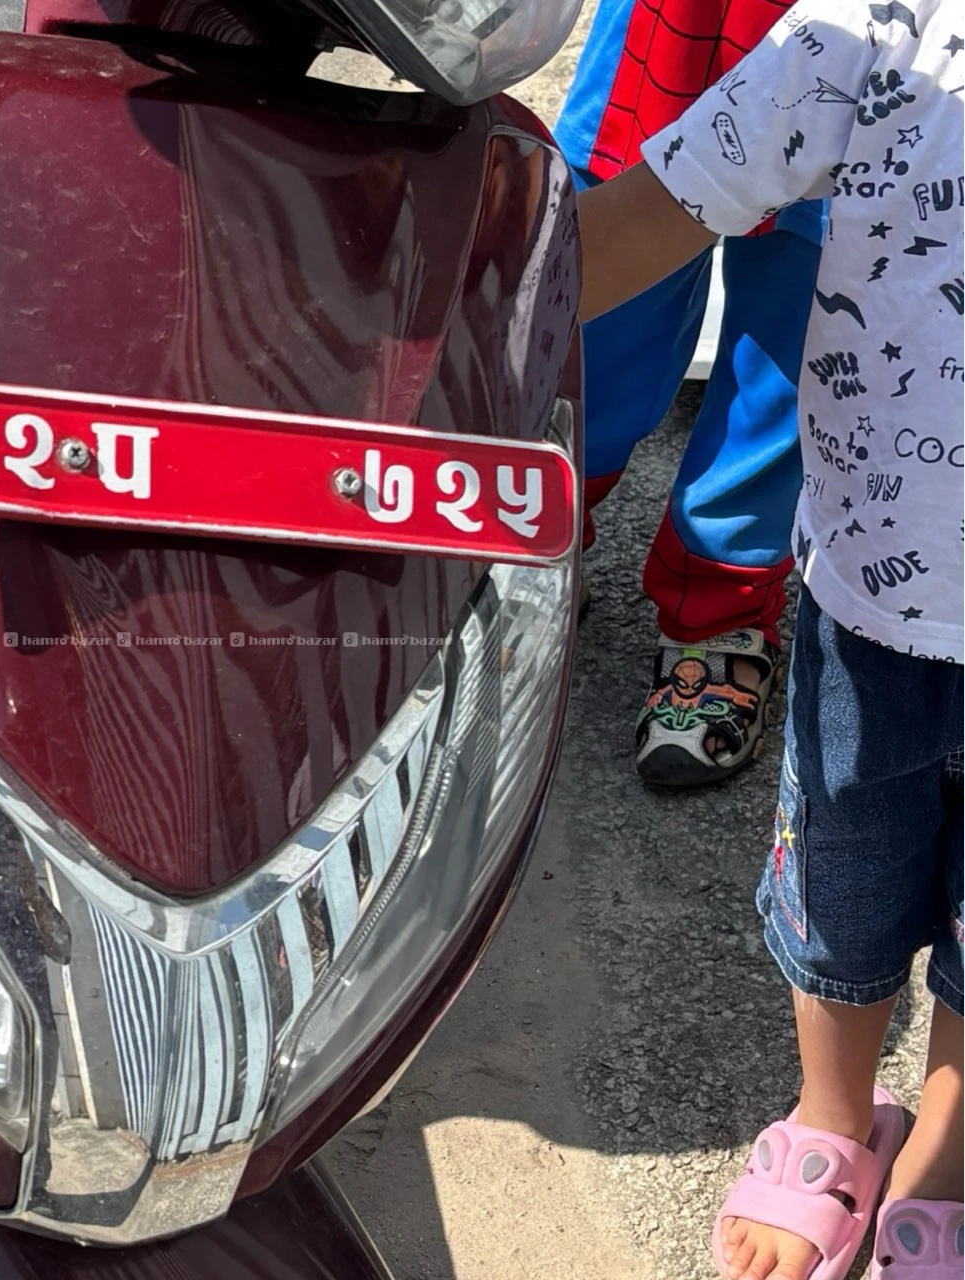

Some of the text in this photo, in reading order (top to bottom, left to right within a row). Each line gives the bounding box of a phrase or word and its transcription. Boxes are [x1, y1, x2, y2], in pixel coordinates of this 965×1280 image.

[882, 147, 909, 176] to
[91, 422, 160, 500] प
[847, 431, 868, 461] to
[862, 473, 903, 506] FUN
[861, 551, 929, 597] DUDE
